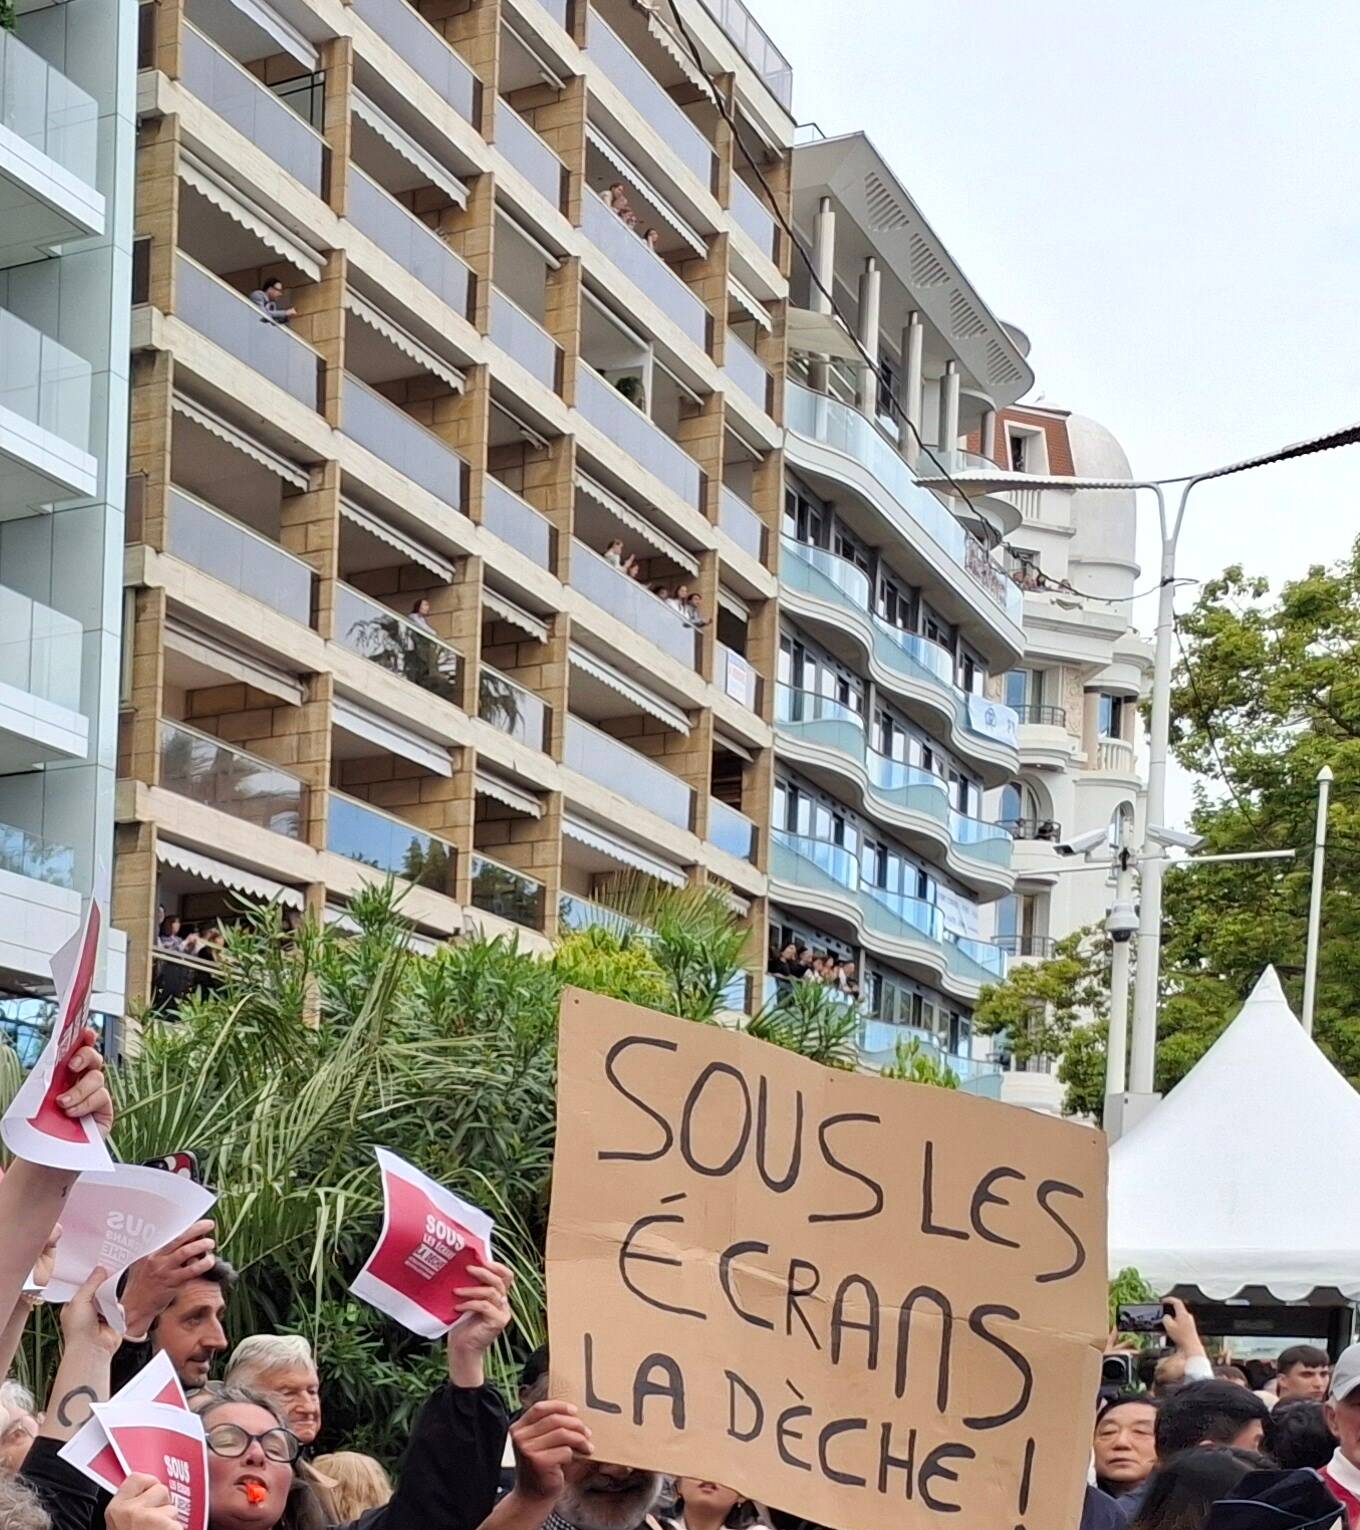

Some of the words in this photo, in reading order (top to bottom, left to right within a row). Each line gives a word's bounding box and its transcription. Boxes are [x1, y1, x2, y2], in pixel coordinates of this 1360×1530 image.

[426, 1214, 465, 1252] SOUS
[599, 1035, 883, 1223] SOUS
[921, 1140, 1087, 1284] LES
[619, 1192, 1034, 1430] ÉCRANS
[164, 1454, 190, 1484] SOUS
[584, 1332, 685, 1430] LA
[724, 1377, 976, 1513] DÈCHE
